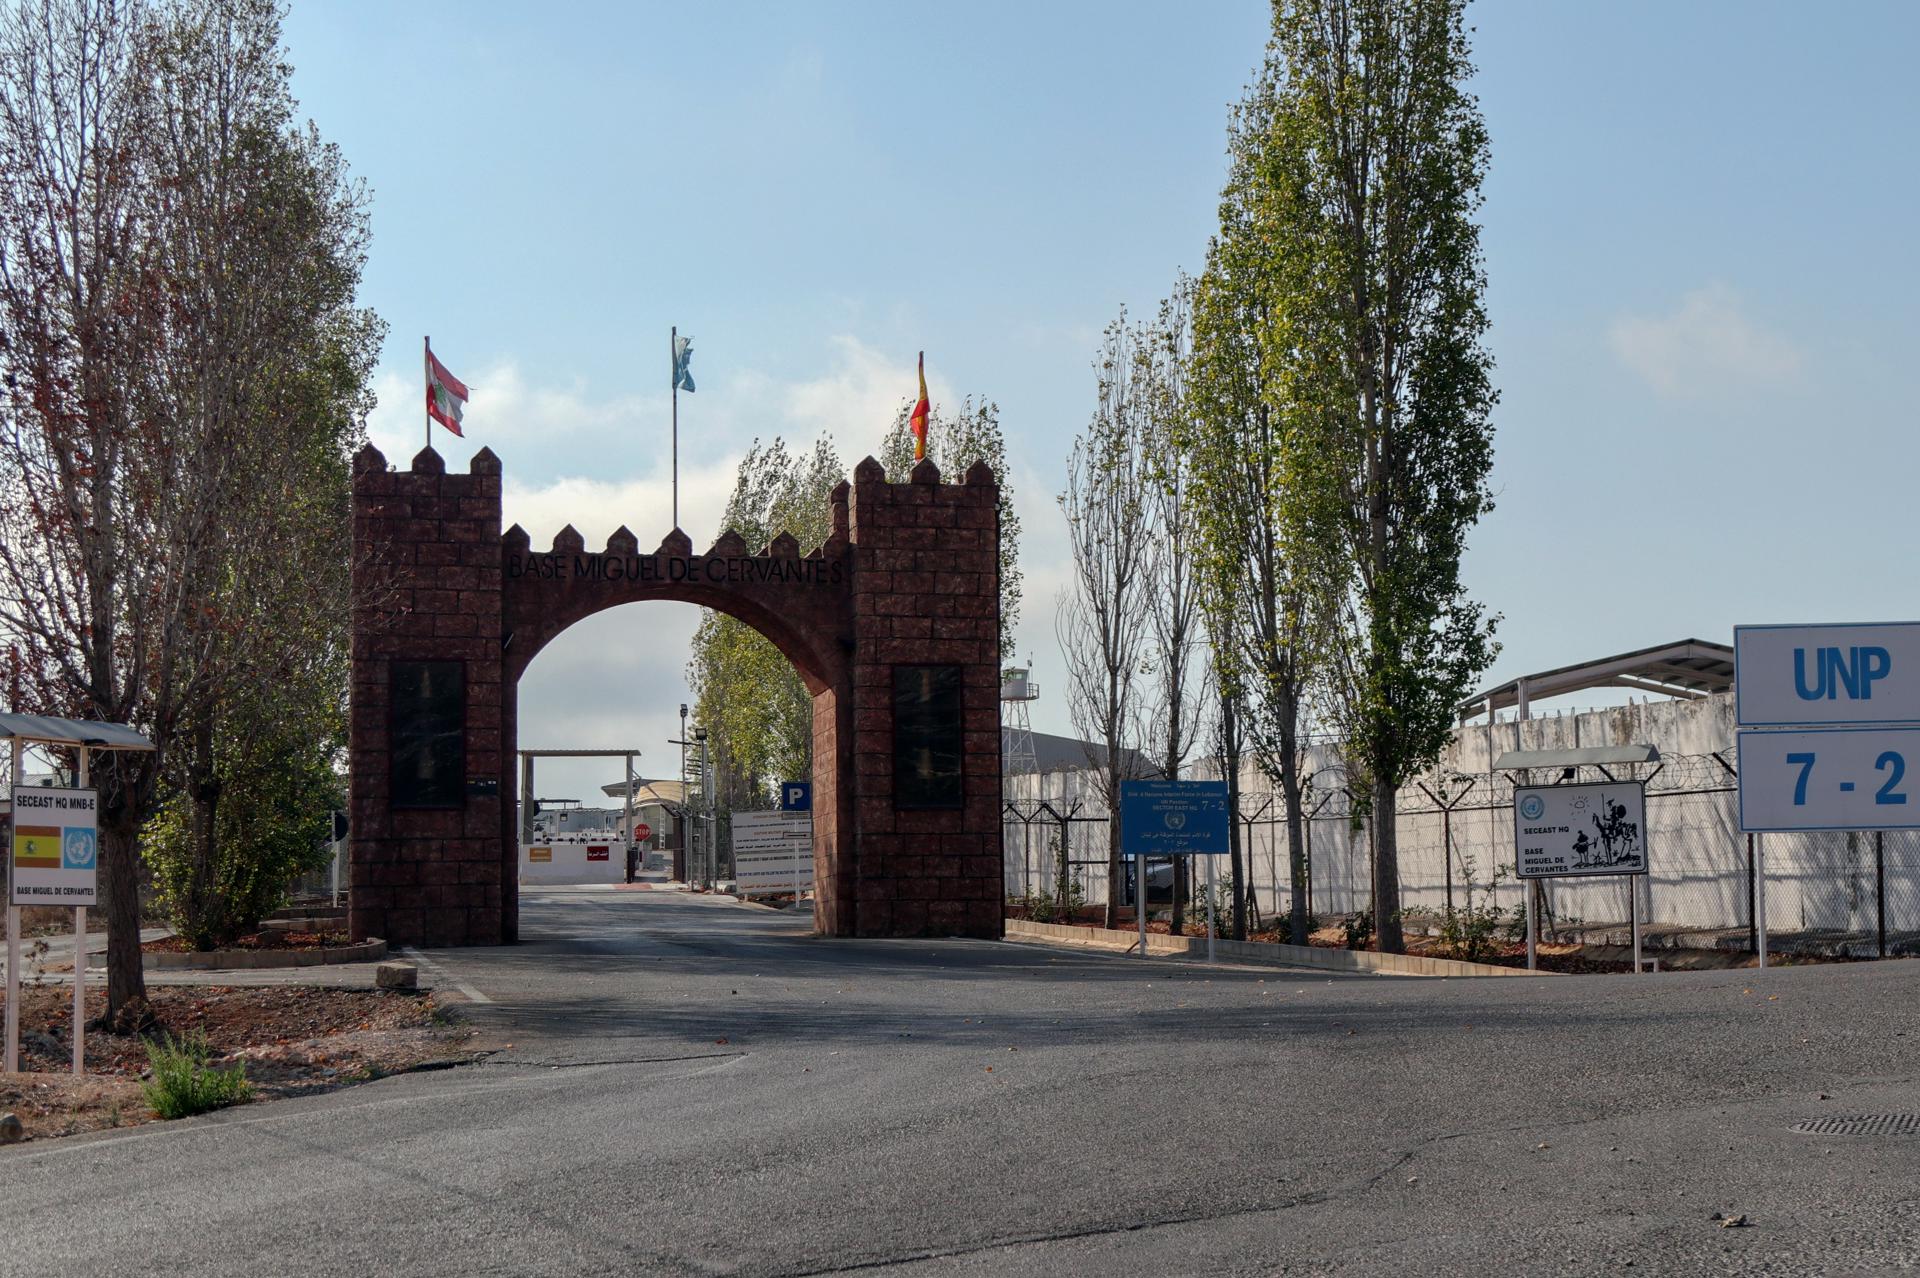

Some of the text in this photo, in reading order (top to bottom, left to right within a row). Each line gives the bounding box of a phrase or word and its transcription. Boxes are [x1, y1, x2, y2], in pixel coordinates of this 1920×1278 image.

[509, 554, 843, 584] BASE MIGUEL DE CERVANTES
[1793, 646, 1892, 701] UNP
[17, 795, 94, 810] SECEAST HQ MNB-E
[789, 788, 804, 804] P
[635, 828, 650, 836] STOP
[1524, 826, 1556, 834] SECEAST
[16, 886, 31, 894] BASE
[32, 887, 54, 895] MIGUEL
[54, 888, 62, 896] DE
